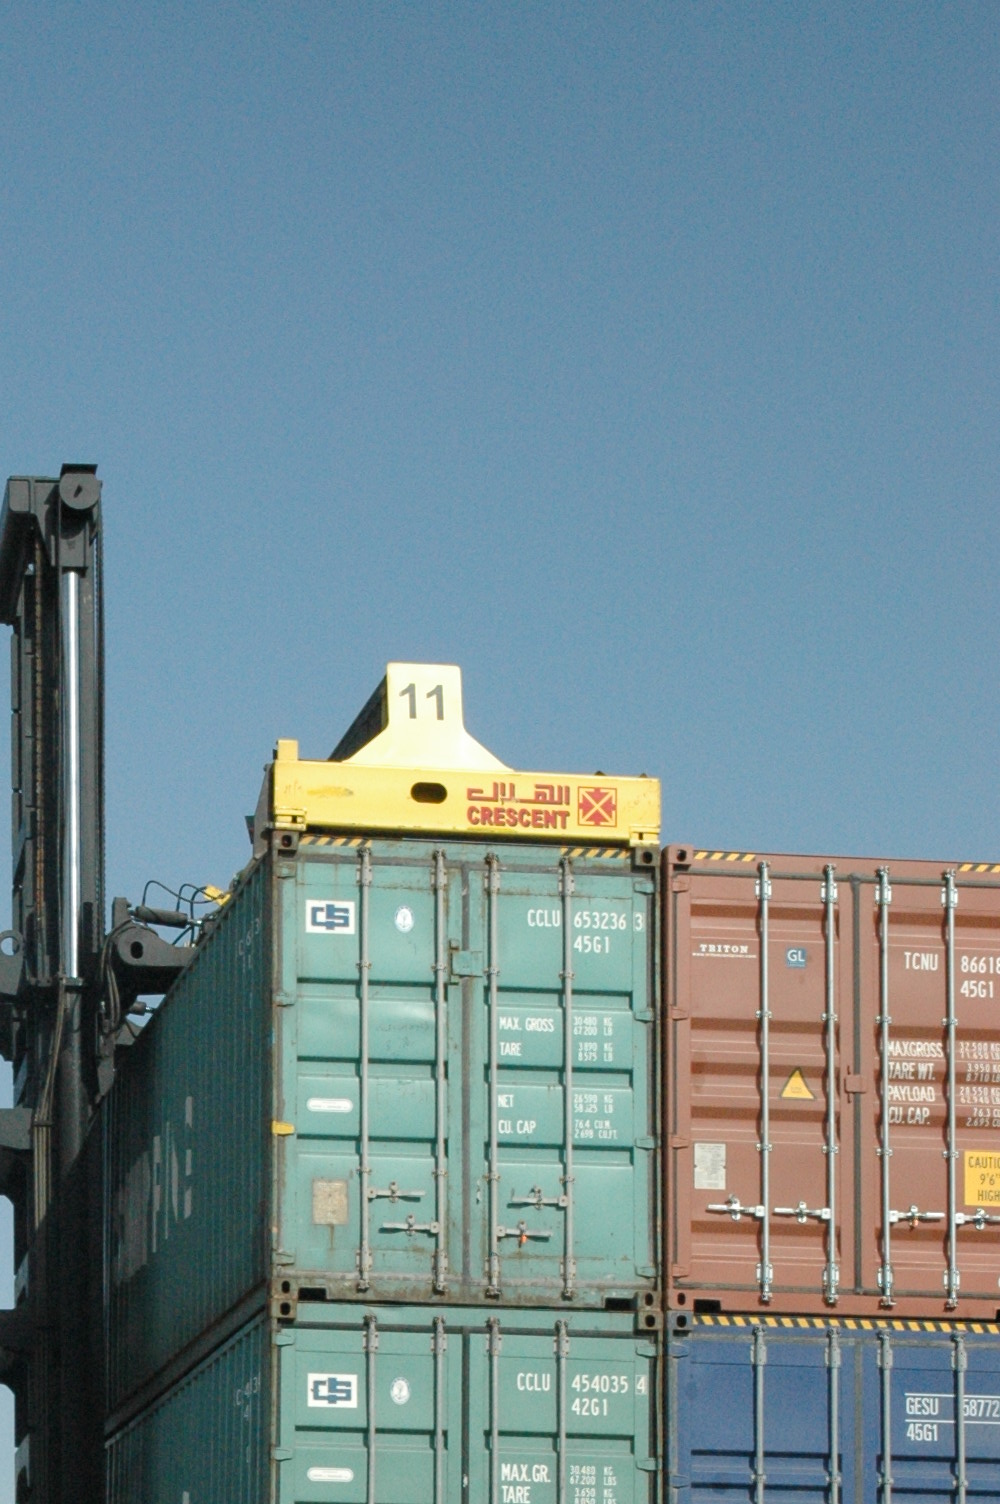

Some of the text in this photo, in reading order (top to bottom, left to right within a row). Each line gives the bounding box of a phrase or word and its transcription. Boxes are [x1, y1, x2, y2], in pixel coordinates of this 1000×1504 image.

[399, 683, 444, 721] 11
[467, 806, 570, 829] CRESCENT
[527, 909, 560, 927] CCLU
[574, 911, 626, 930] 653236
[574, 936, 609, 953] 45G1
[699, 943, 748, 953] TRITON
[787, 949, 806, 962] GL
[904, 952, 938, 971] TCNU
[960, 980, 994, 998] 45G1
[525, 1017, 554, 1032] GROSS
[500, 1042, 522, 1056] TARE
[888, 1062, 915, 1080] TARE
[498, 1094, 514, 1107] NET
[888, 1086, 935, 1102] PAYLOAD
[517, 1120, 536, 1134] CAP
[517, 1373, 550, 1391] CCLU
[571, 1375, 628, 1393] 454035
[571, 1398, 607, 1416] 42G1
[906, 1397, 939, 1415] GESU
[907, 1423, 938, 1441] 45G1
[502, 1485, 531, 1504] TARE
